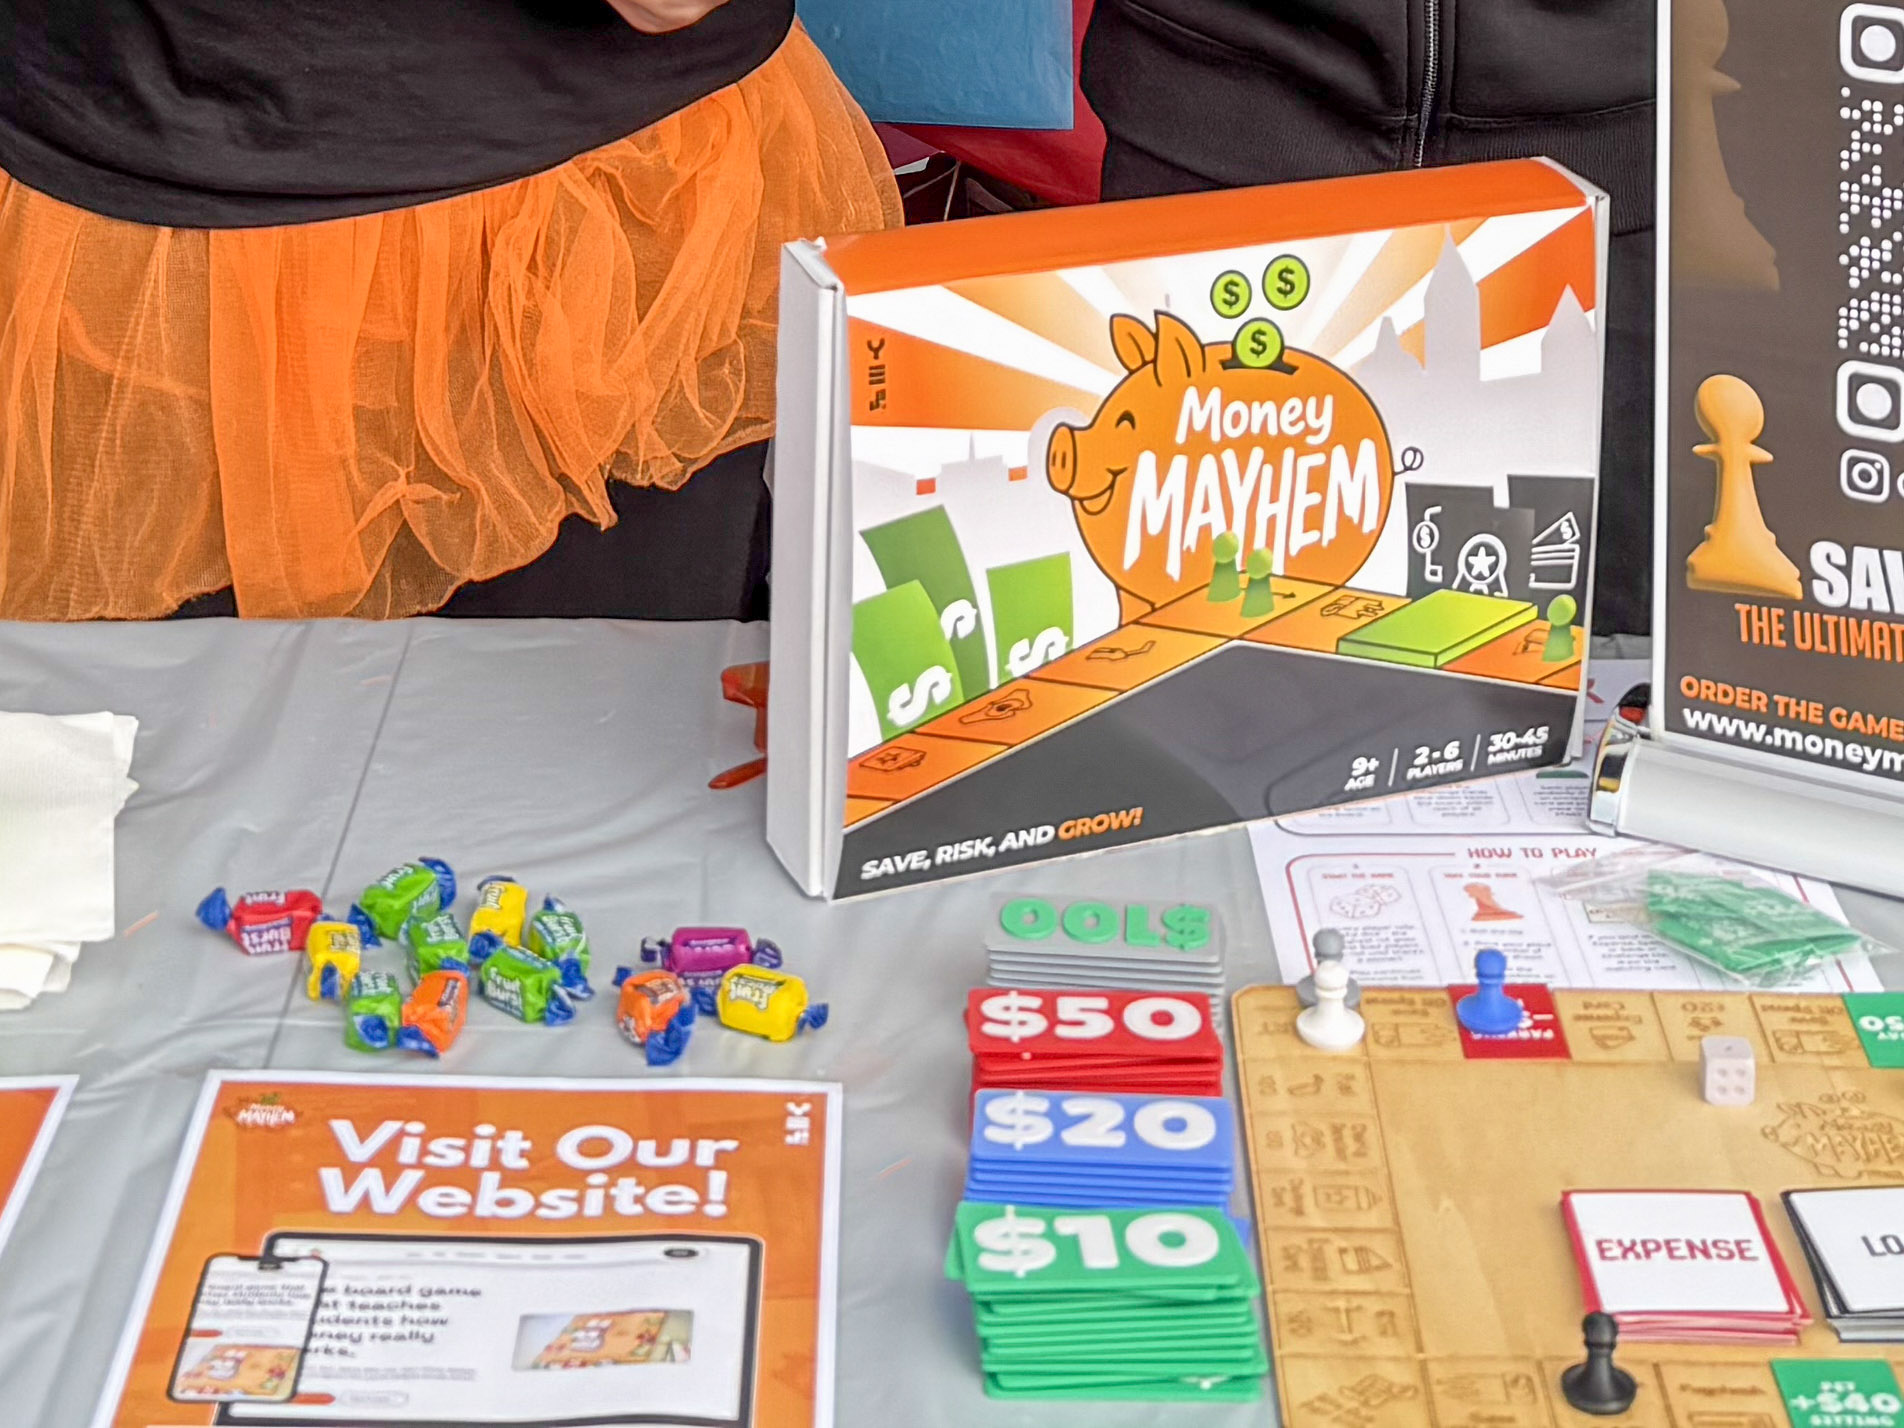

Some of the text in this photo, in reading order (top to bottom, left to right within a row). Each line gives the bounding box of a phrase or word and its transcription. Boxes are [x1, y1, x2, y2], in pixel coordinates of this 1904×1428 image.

[1175, 386, 1334, 446] Money
[1123, 437, 1382, 581] MAYHEM
[1735, 602, 1787, 648] THE
[1679, 675, 1771, 719] ORDER
[1773, 692, 1825, 727] THE
[1487, 746, 1543, 765] MINUTES
[1488, 726, 1549, 753] 30-45
[1345, 774, 1375, 791] AGE
[1352, 756, 1380, 777] 9+
[1407, 759, 1464, 780] PLAYERS
[860, 806, 1144, 882] SAVE, RISK, AND GROW!
[1467, 846, 1598, 860] HOW TO PLAY
[980, 991, 1203, 1041] $50
[235, 1107, 296, 1128] MAYHEM
[982, 1090, 1217, 1151] $20
[328, 1117, 740, 1170] Visit Our
[317, 1166, 728, 1218] Website!
[971, 1204, 1222, 1278] $10
[1595, 1234, 1761, 1264] EXPENSE
